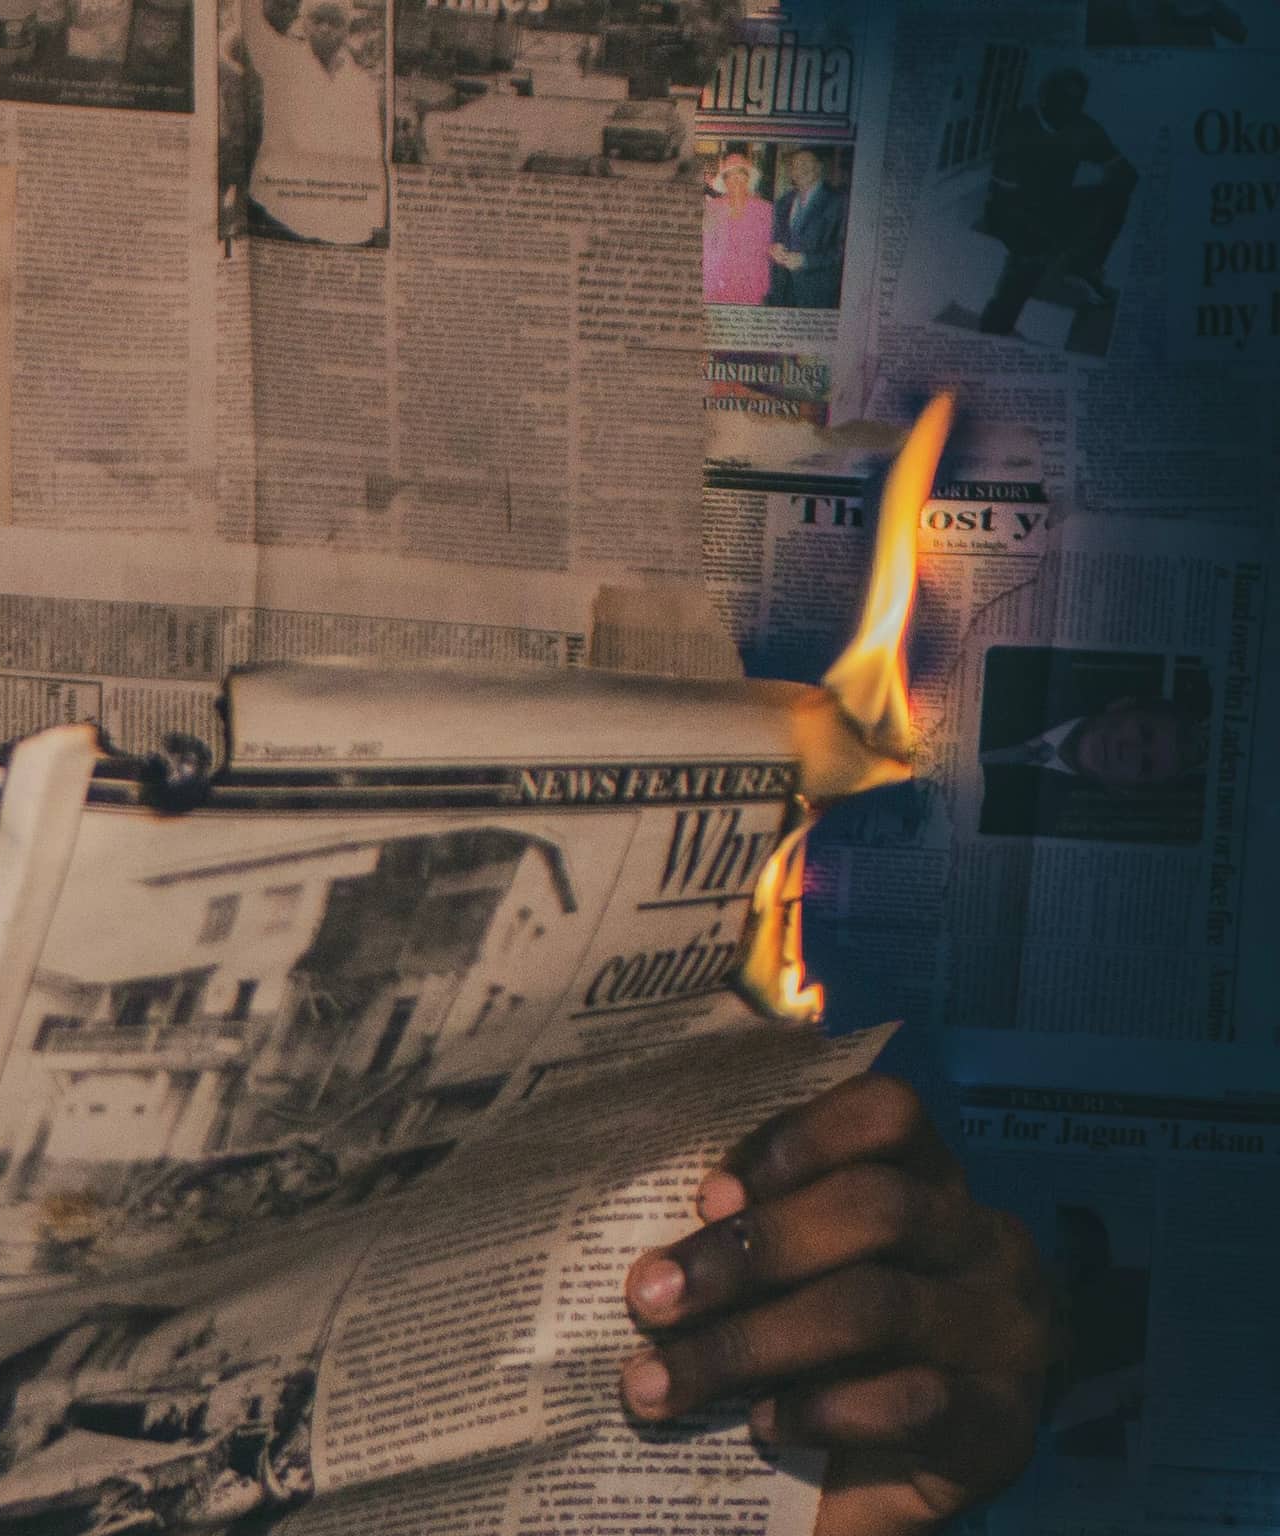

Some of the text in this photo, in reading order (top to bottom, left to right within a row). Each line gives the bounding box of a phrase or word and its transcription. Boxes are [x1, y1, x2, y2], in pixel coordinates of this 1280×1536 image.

[784, 364, 828, 392] beg
[975, 486, 1031, 500] STORY
[518, 767, 620, 800] NEWS
[584, 919, 737, 1010] contin
[1001, 1114, 1046, 1142] for
[1052, 1117, 1148, 1152] Jagun
